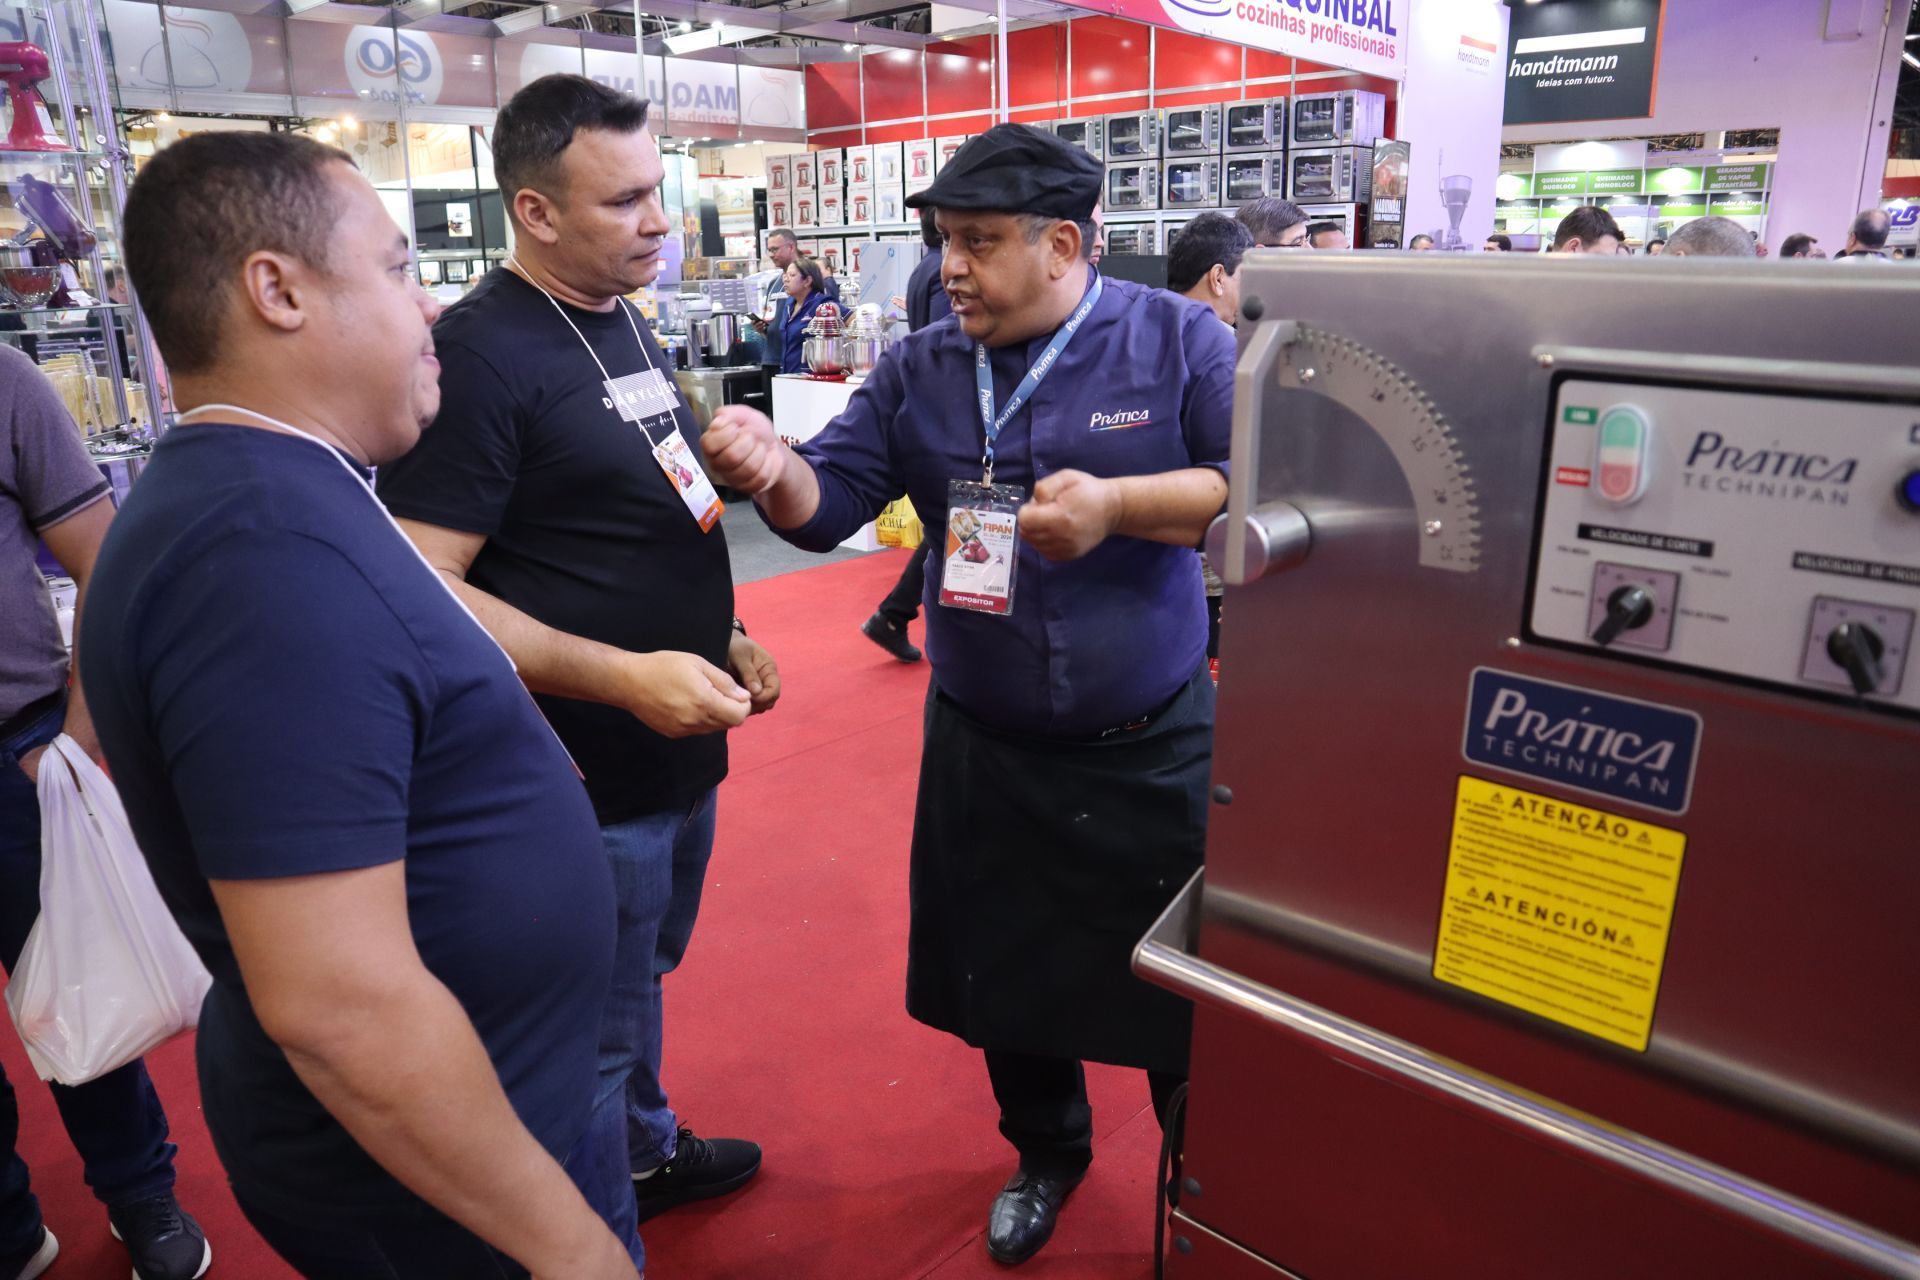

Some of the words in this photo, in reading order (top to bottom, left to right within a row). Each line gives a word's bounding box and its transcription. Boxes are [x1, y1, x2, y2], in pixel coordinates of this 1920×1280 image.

[1236, 1, 1306, 36] cozinhas
[1310, 21, 1397, 60] profissionais
[1509, 55, 1619, 78] handtmann
[1536, 79, 1563, 88] Ideias
[1564, 77, 1582, 86] com
[1584, 75, 1615, 85] futuro.
[1325, 362, 1334, 375] 5
[1089, 408, 1150, 428] PRÁTICA
[1410, 434, 1428, 453] 15
[1686, 430, 1859, 484] PRÁTICA
[1682, 472, 1850, 505] TECHNIPAN
[983, 522, 1013, 535] FIPAN
[953, 594, 994, 607] EXPOSITOR
[1483, 688, 1675, 772] PRÁTICA
[1483, 734, 1671, 796] TECHNIPAN
[1512, 795, 1630, 839] ATENÇÃO
[1483, 890, 1617, 944] ATENCIÓN
